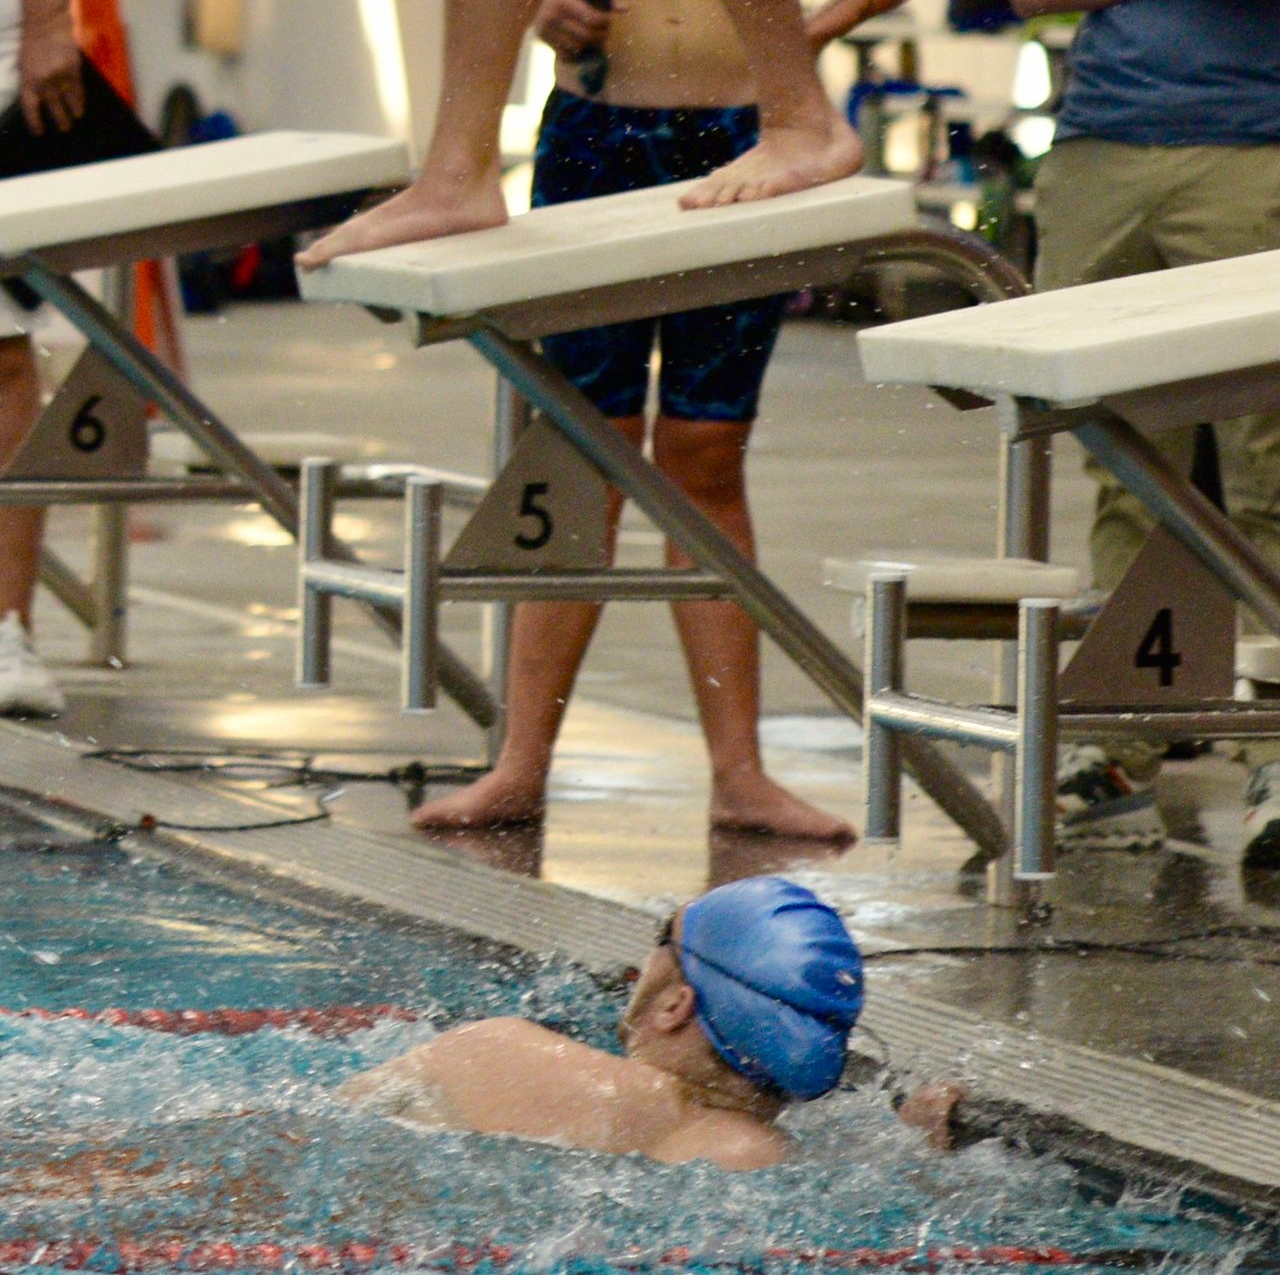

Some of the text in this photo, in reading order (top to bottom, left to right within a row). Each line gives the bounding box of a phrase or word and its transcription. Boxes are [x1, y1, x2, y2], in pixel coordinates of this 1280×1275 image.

[70, 393, 107, 453] 6
[515, 482, 553, 550] 5
[1134, 608, 1182, 687] 4
